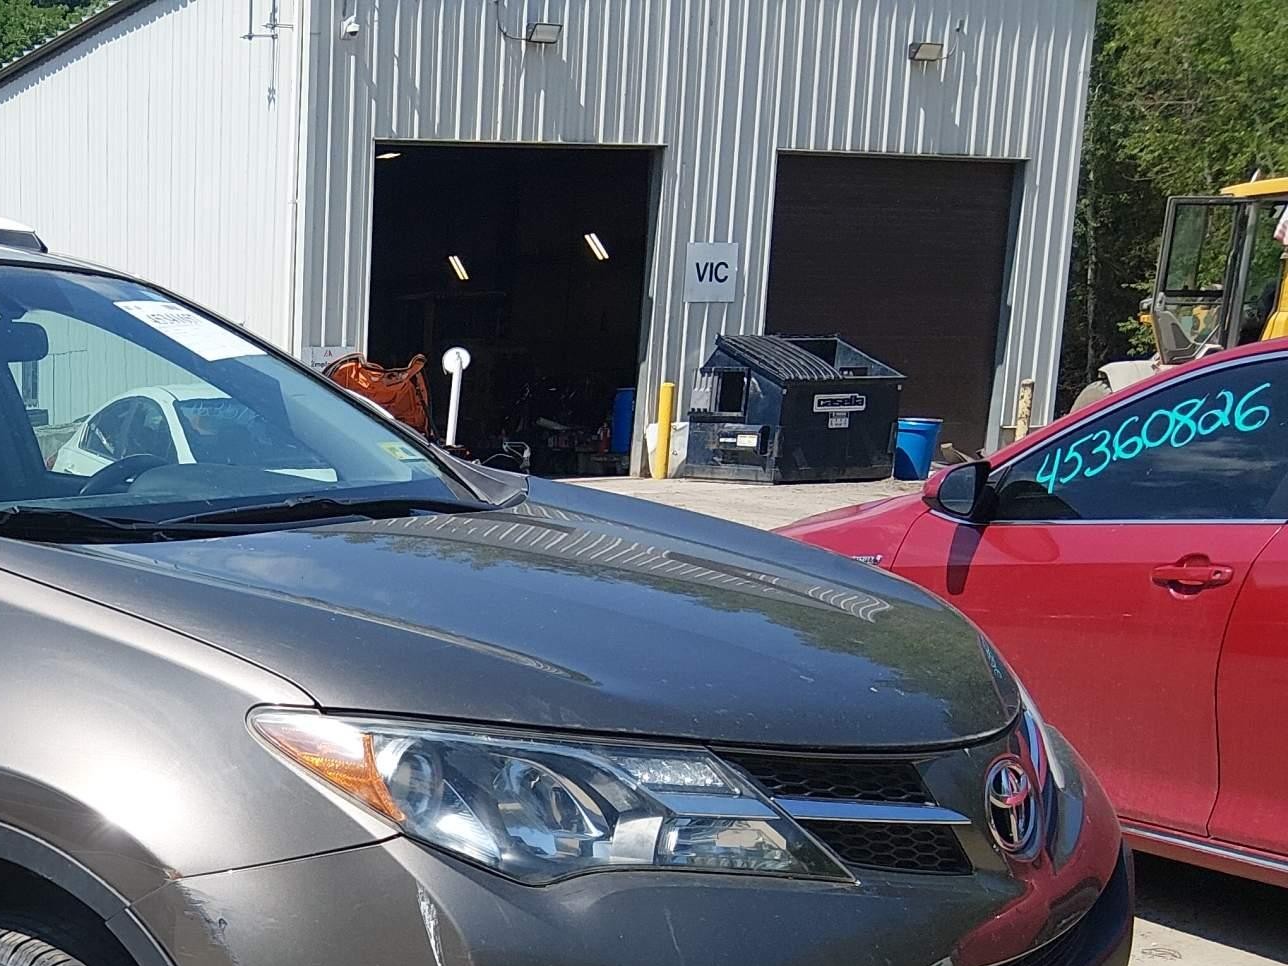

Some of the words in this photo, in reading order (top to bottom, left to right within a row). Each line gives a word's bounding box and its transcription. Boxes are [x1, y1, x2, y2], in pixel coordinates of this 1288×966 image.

[695, 261, 729, 283] VIC
[817, 395, 864, 407] casella
[1036, 383, 1271, 494] 45360826
